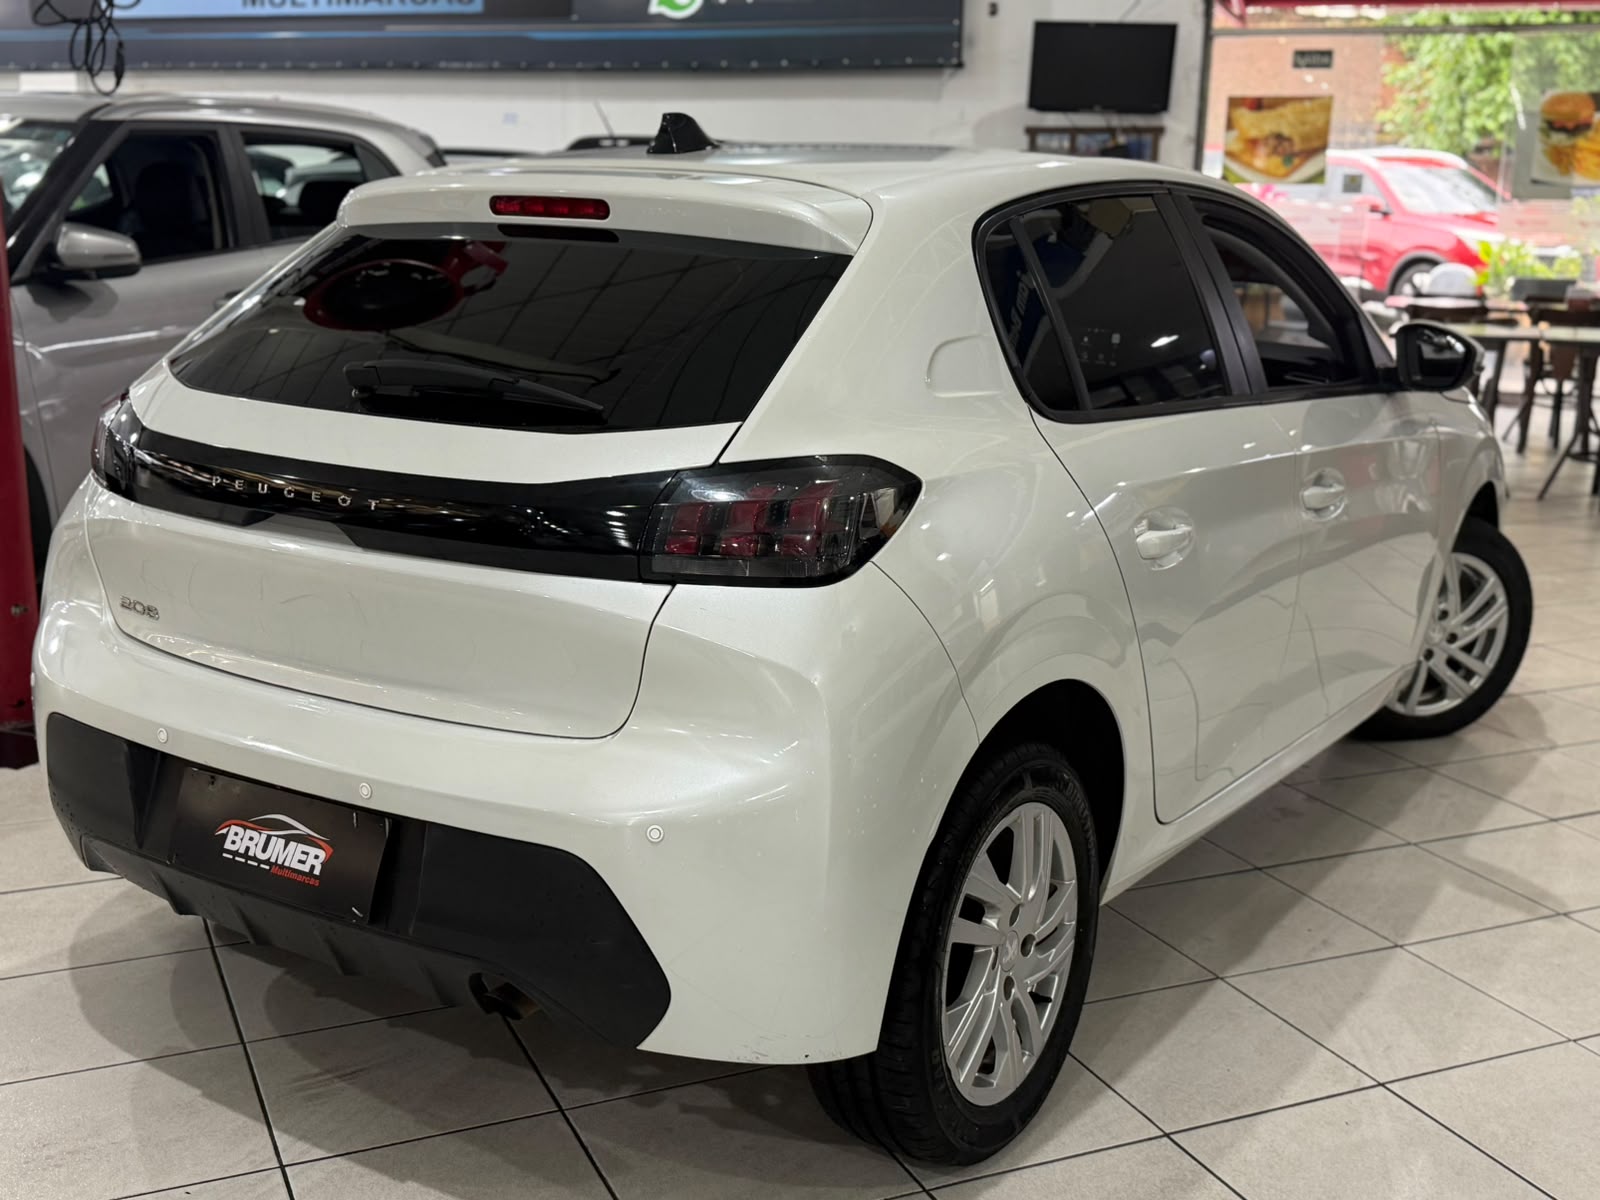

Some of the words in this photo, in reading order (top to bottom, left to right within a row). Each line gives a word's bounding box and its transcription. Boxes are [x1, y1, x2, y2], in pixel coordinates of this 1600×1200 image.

[212, 475, 380, 510] PEUGEOT
[120, 595, 160, 620] 208
[224, 825, 326, 875] BRUMER
[271, 866, 320, 886] Multimarcas
